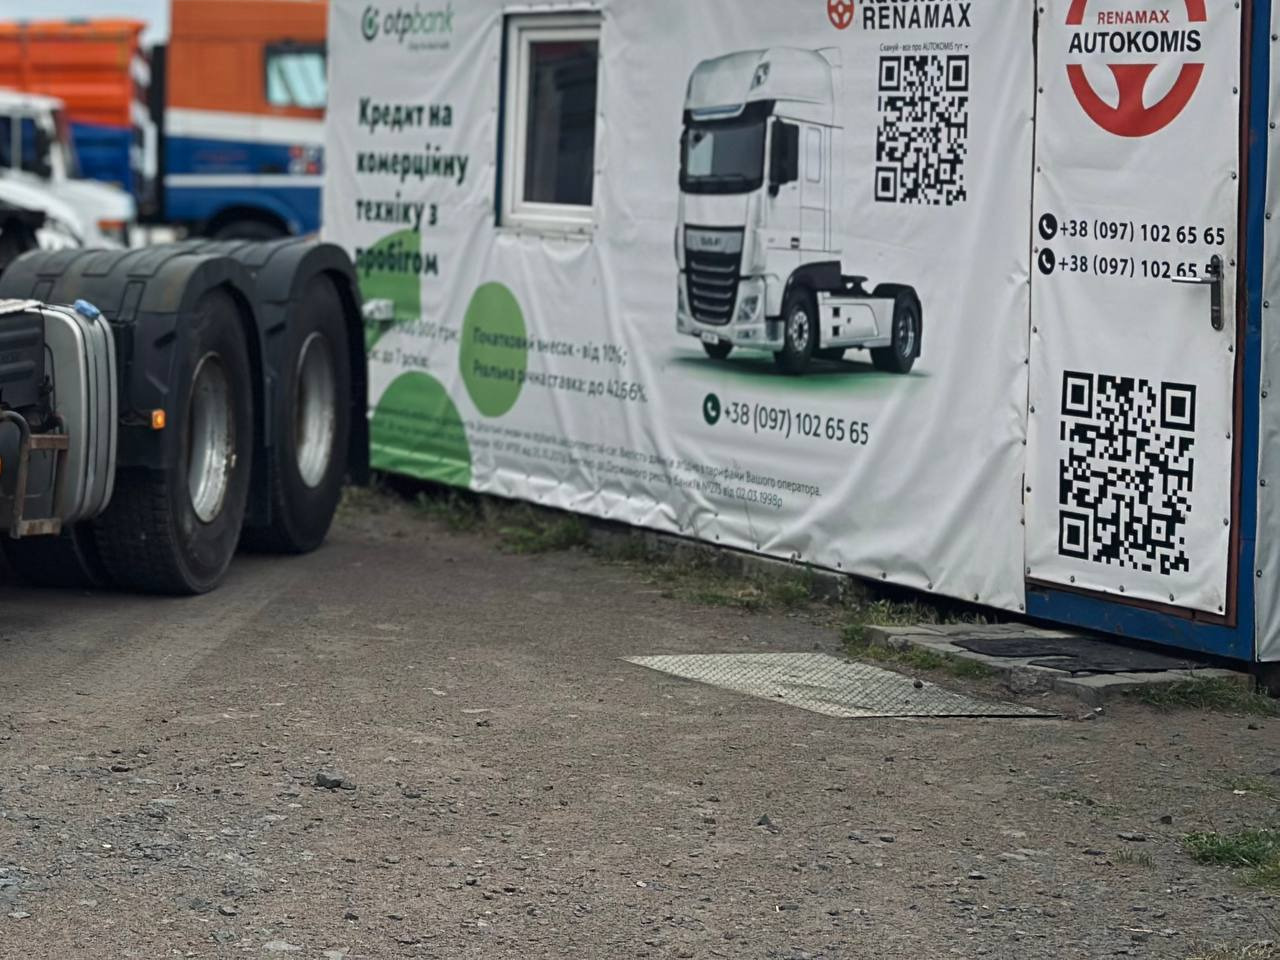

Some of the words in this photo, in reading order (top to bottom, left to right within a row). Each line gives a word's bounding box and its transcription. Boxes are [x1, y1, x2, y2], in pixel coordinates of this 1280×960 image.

[862, 3, 972, 30] RENAMAX
[1097, 9, 1171, 25] RENAMAX
[1068, 29, 1202, 54] AUTOKOMIS
[358, 97, 424, 134] Кредит
[428, 104, 453, 128] на
[356, 143, 469, 185] комерційну
[356, 191, 425, 231] техніку
[428, 204, 438, 227] з
[1059, 219, 1089, 238] +38
[1092, 219, 1135, 243] (097)
[1140, 223, 1171, 244] 102
[1176, 225, 1198, 245] 65
[1203, 226, 1225, 246] 65
[355, 238, 439, 278] пробігом
[1058, 254, 1089, 274] +38
[1092, 254, 1135, 279] (097)
[1141, 259, 1171, 280] 102
[1176, 262, 1198, 278] 65
[723, 401, 750, 426] +38
[753, 401, 792, 440] (097)
[796, 410, 821, 437] 102
[825, 416, 845, 442] 65
[849, 419, 870, 446] 65
[745, 469, 776, 489] Вашого
